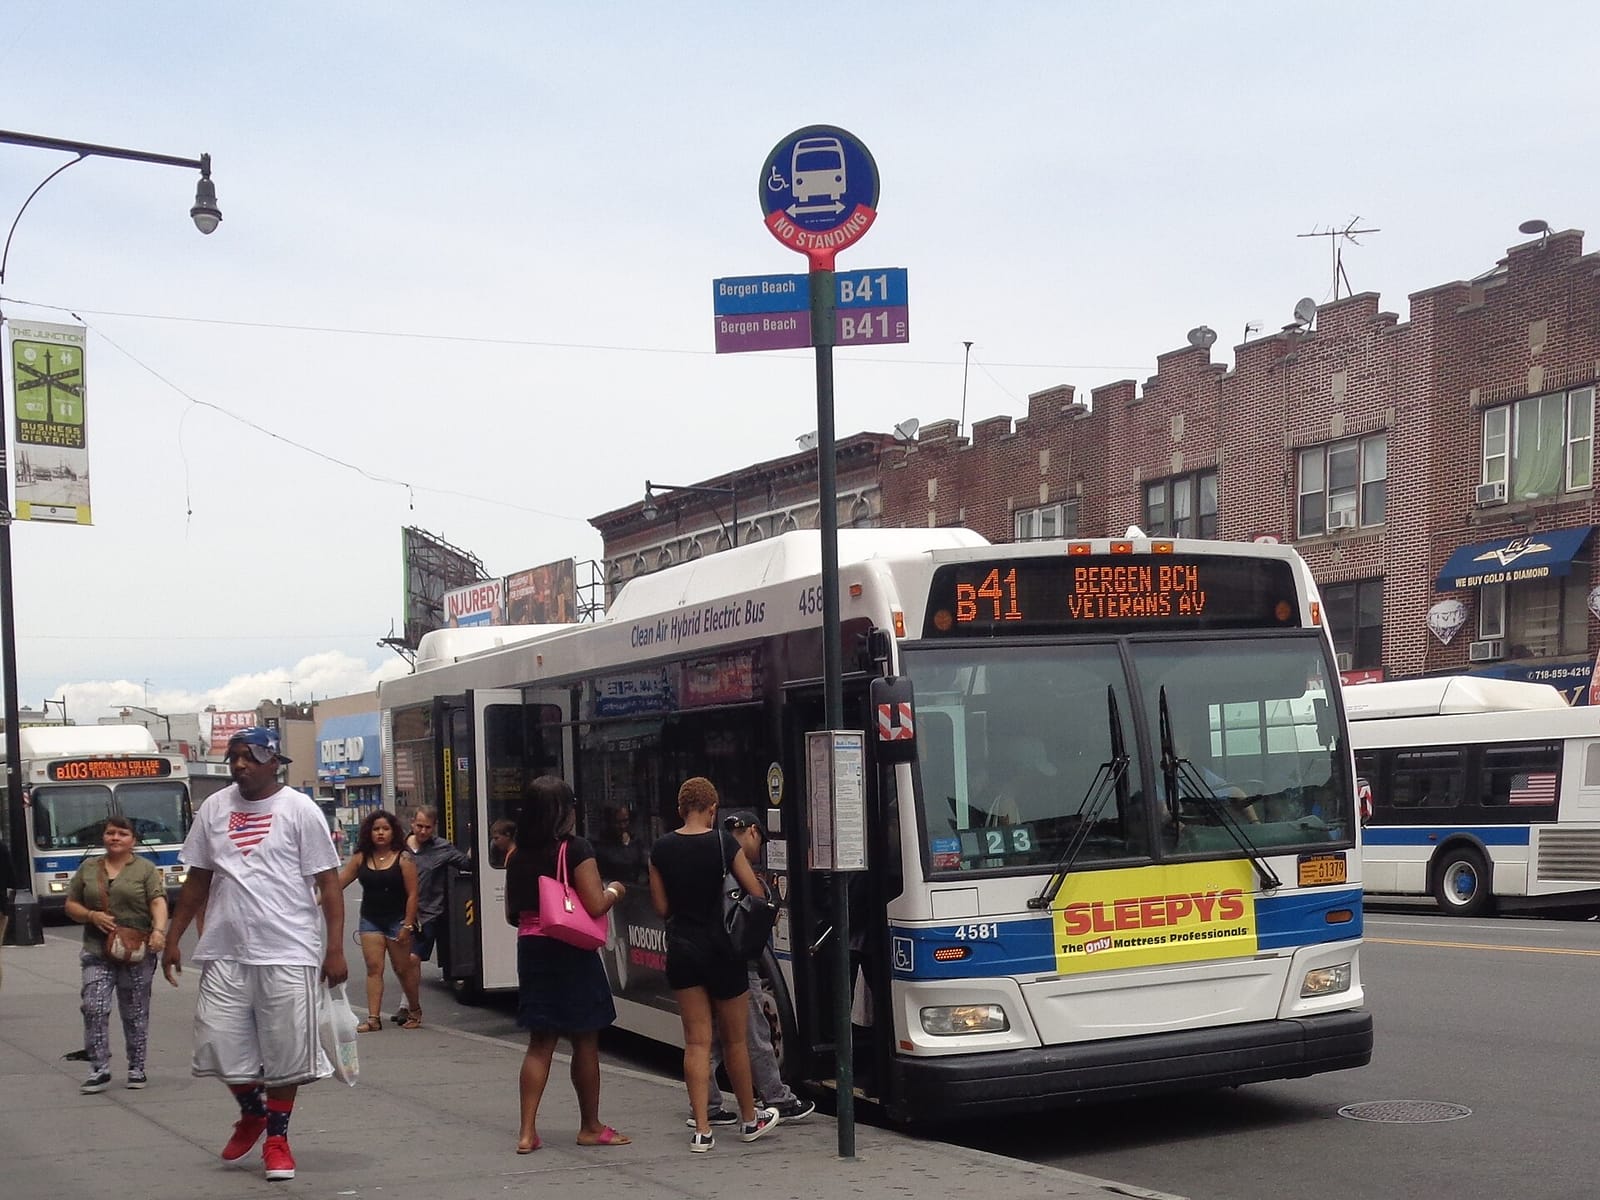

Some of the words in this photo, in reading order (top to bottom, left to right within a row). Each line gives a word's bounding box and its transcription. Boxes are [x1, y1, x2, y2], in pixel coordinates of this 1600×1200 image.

[774, 217, 794, 239] NO
[796, 212, 868, 249] STANDING
[719, 282, 758, 298] Bergen
[762, 280, 795, 294] Beach
[840, 274, 888, 303] B41
[11, 327, 32, 337] THE
[720, 320, 759, 334] Bergen
[763, 317, 797, 331] Beach
[842, 311, 889, 340] B41
[896, 321, 906, 338] LTD
[21, 422, 81, 435] BUSINESS
[21, 434, 81, 446] DISTRICT
[1074, 565, 1152, 594] BERGEN
[1159, 564, 1198, 592] BCH
[1455, 577, 1467, 588] WE
[1467, 576, 1483, 587] BUY
[1483, 573, 1505, 585] GOLD
[1505, 571, 1512, 581] &
[1513, 567, 1549, 580] DIAMOND
[448, 583, 500, 616] INJURED?
[956, 568, 1022, 622] B41
[1068, 593, 1171, 619] VETERANS
[1178, 591, 1206, 616] AV
[631, 624, 654, 648] Clean
[656, 619, 669, 641] Air
[670, 609, 701, 645] Hybrid
[703, 602, 742, 633] Electric
[744, 599, 766, 625] Bus
[799, 585, 823, 617] 458
[56, 762, 88, 779] B103
[129, 760, 160, 769] COLLEGE
[986, 831, 1004, 853] 2
[1013, 829, 1031, 851] 3
[628, 925, 662, 951] NOBODY
[954, 923, 998, 941] 4581
[1062, 944, 1083, 954] The
[1085, 938, 1111, 954] Only
[1113, 935, 1166, 948] Mattress
[1169, 927, 1248, 943] Professionals
